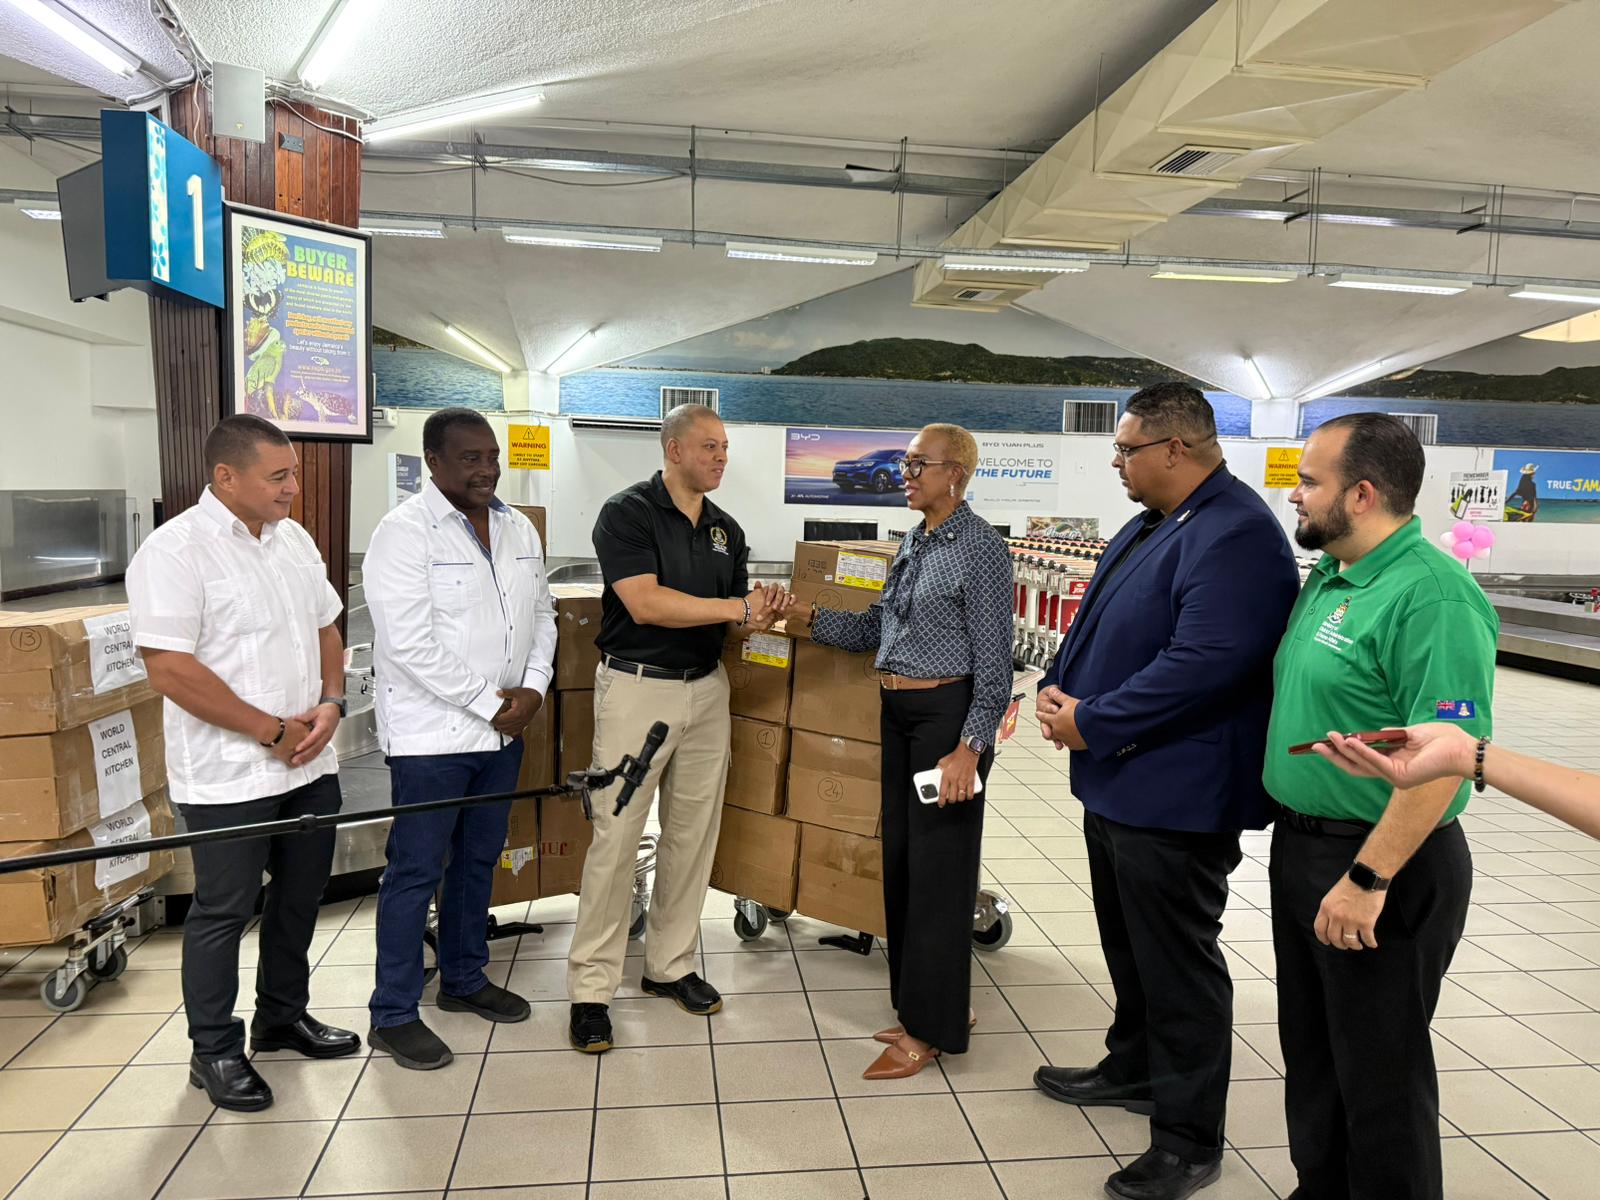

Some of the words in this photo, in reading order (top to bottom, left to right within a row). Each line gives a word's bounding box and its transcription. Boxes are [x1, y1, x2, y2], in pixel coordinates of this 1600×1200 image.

[186, 174, 204, 271] 1
[294, 244, 348, 271] BUYER
[287, 260, 354, 288] BEWARE
[1036, 458, 1053, 468] TO
[975, 468, 999, 478] THE
[1001, 468, 1052, 479] FUTURE
[1546, 480, 1572, 490] TRUE
[1572, 478, 1600, 492] JAM
[104, 622, 130, 636] WORLD
[18, 631, 36, 649] 13
[106, 657, 134, 672] KITCHEN
[100, 723, 125, 740] WORLD
[102, 739, 132, 760] CENTRAL
[104, 757, 134, 777] KITCHEN
[824, 780, 839, 798] 24
[105, 816, 134, 832] WORLD
